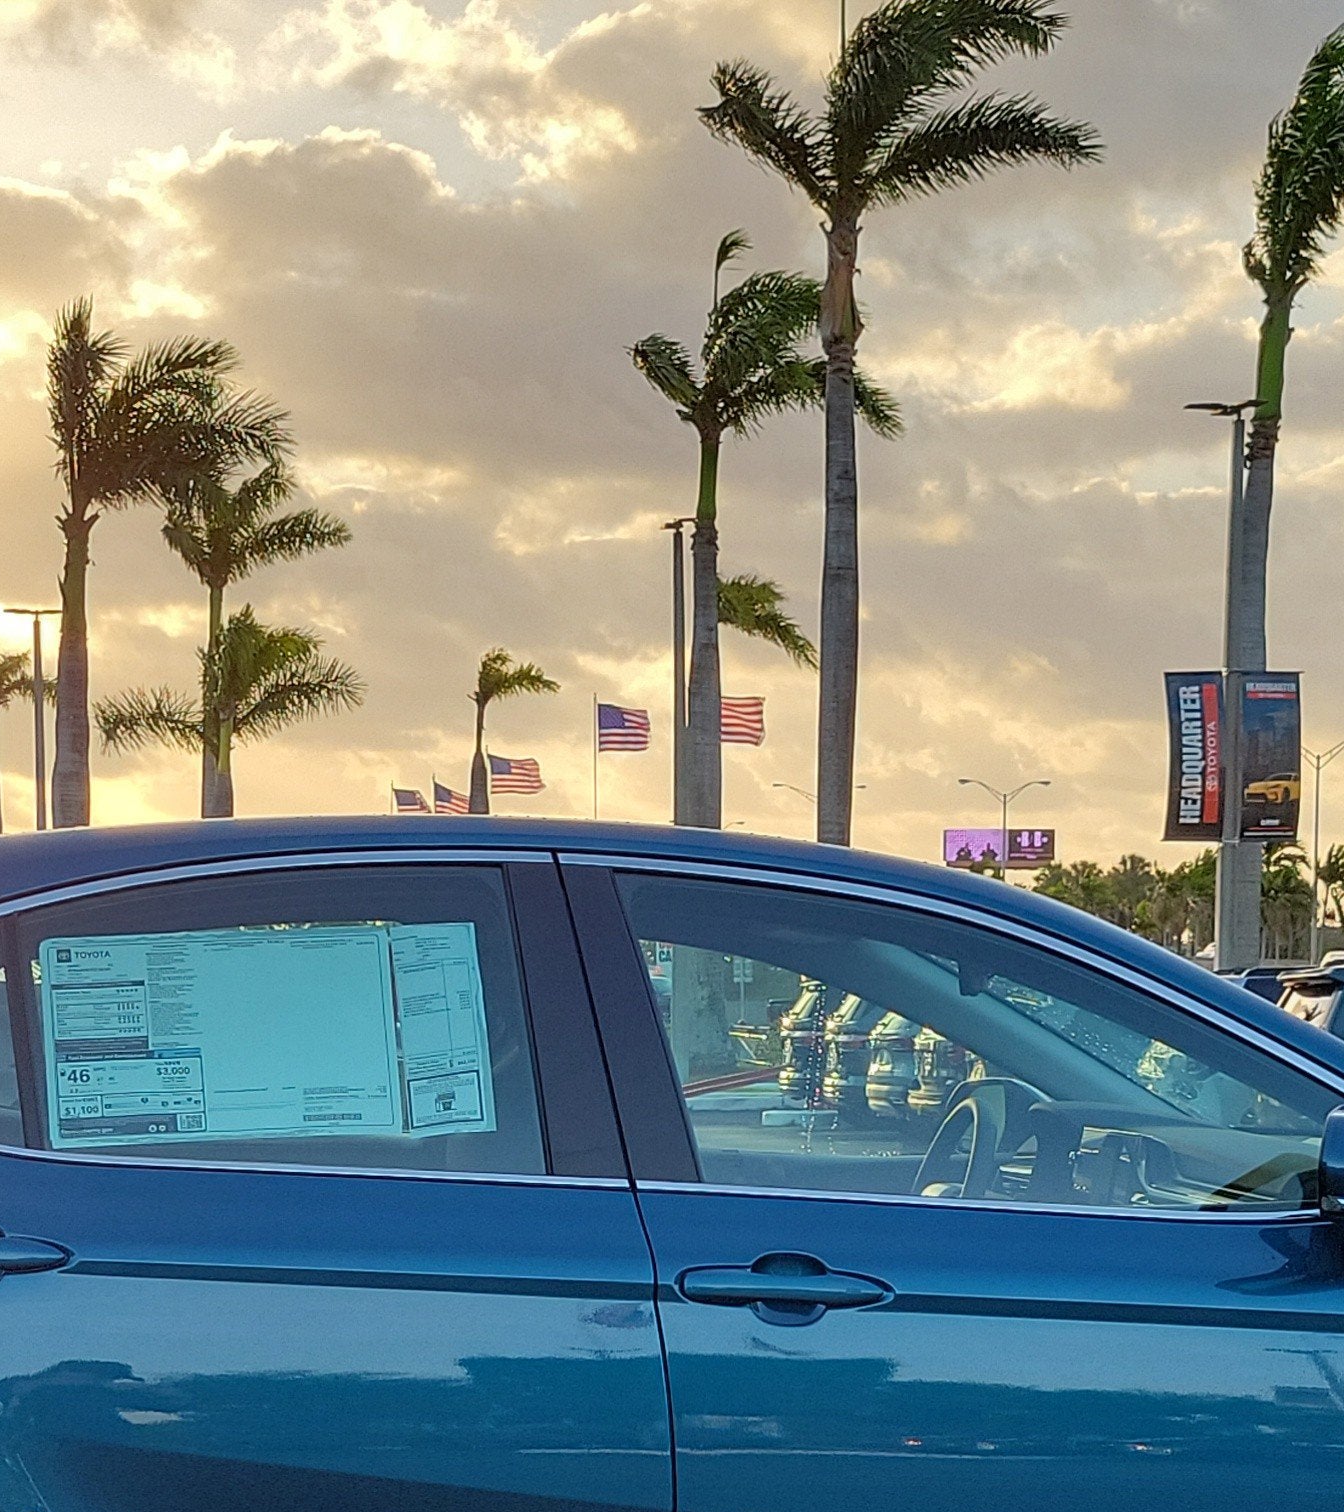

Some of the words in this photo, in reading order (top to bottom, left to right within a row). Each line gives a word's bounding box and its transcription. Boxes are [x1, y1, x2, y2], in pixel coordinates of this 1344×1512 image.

[1178, 685, 1205, 824] HEADQUARTER
[1206, 721, 1218, 774] TOYOTA
[74, 951, 112, 959] TOYOTA
[67, 1069, 91, 1084] 46
